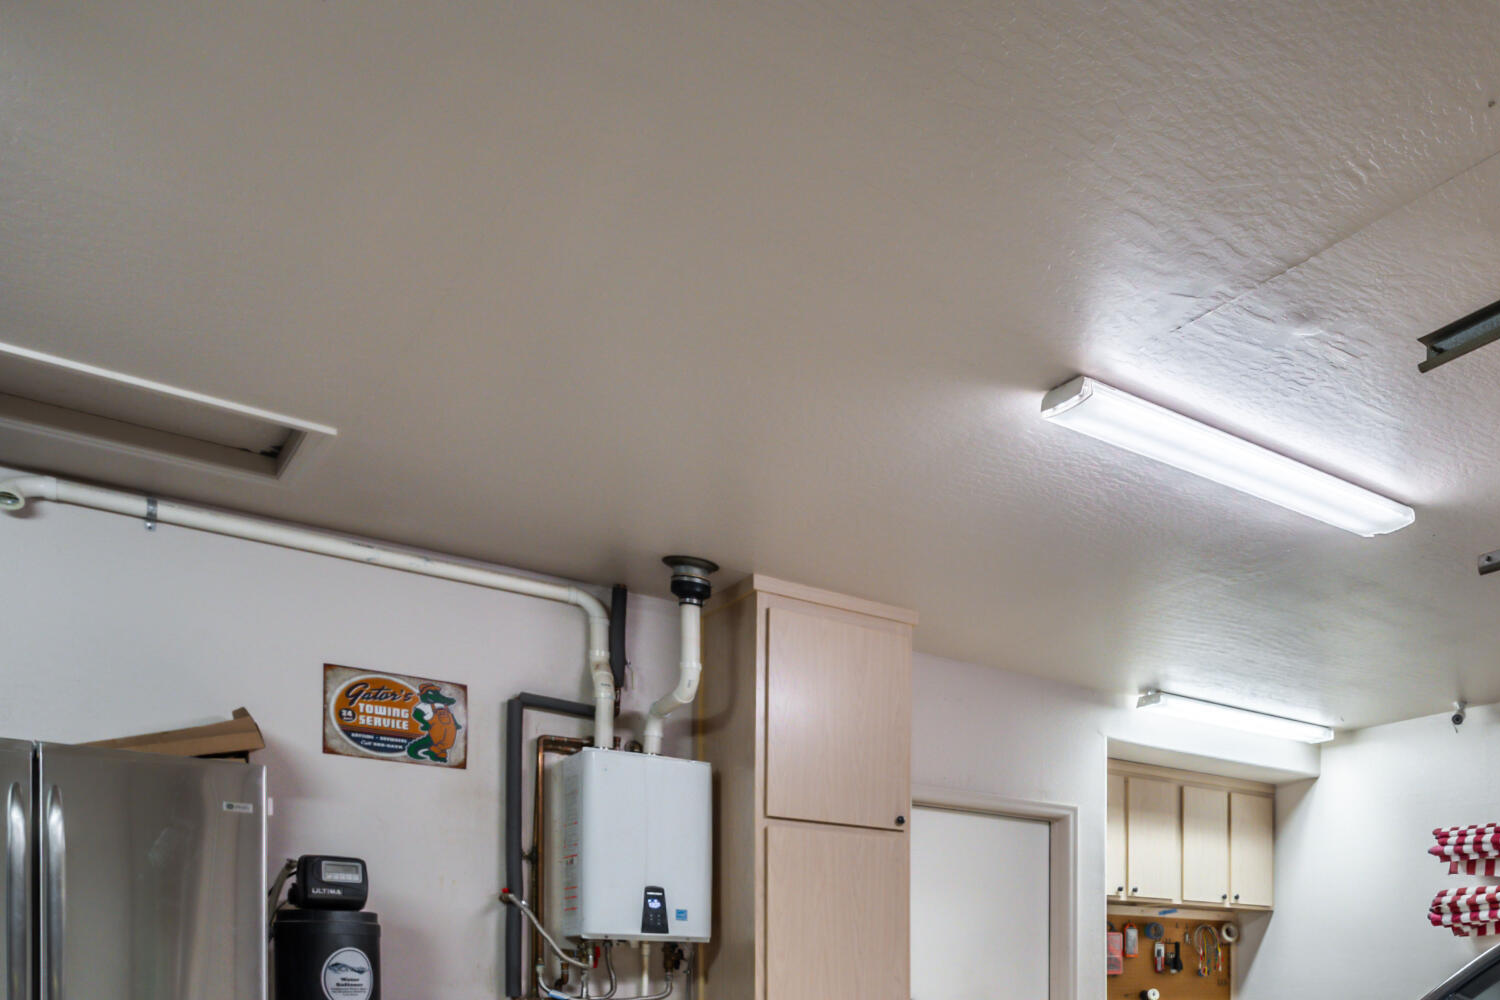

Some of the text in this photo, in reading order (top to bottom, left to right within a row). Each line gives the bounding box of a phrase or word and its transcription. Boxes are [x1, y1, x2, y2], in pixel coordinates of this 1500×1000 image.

[345, 682, 414, 706] Gator's
[359, 703, 409, 718] TOWING
[359, 715, 409, 730] SERVICE
[312, 887, 342, 895] ULTIMA
